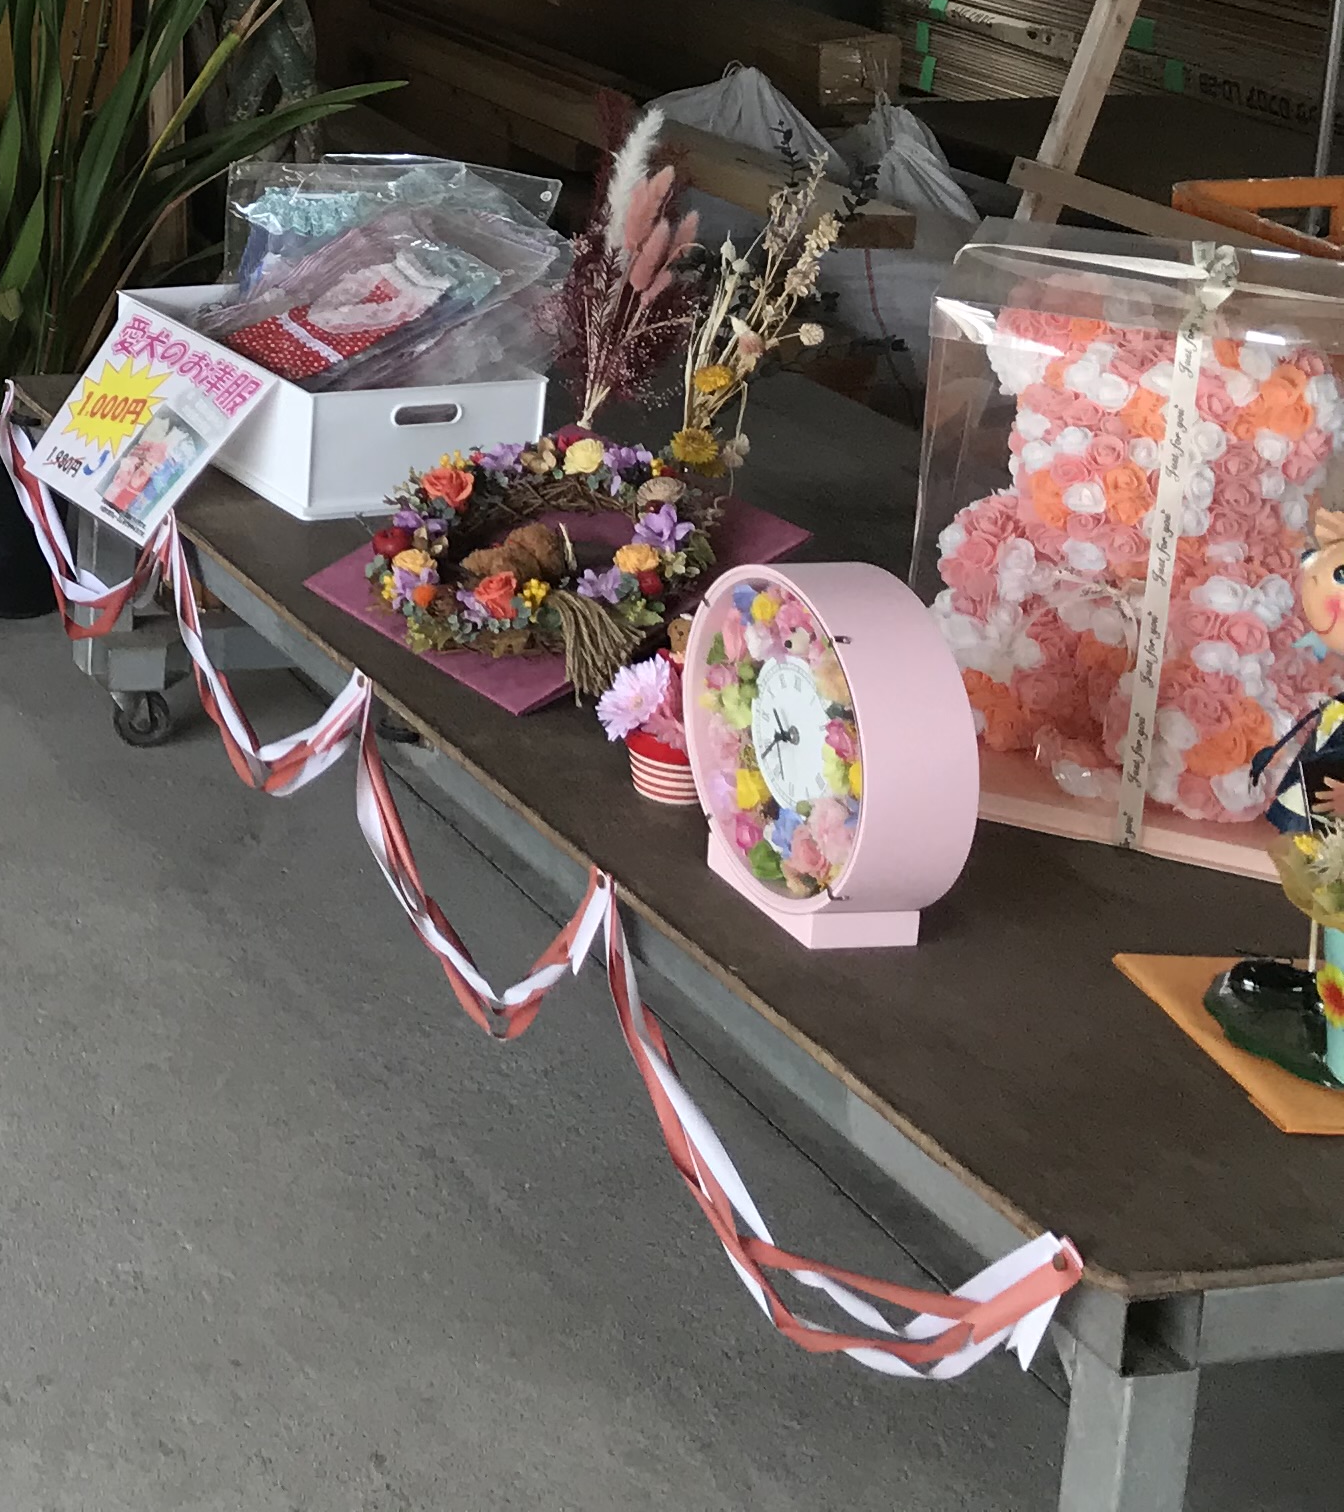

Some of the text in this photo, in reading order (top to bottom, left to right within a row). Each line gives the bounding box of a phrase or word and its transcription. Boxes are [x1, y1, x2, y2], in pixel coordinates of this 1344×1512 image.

[110, 313, 265, 419] 愛犬のお洋服
